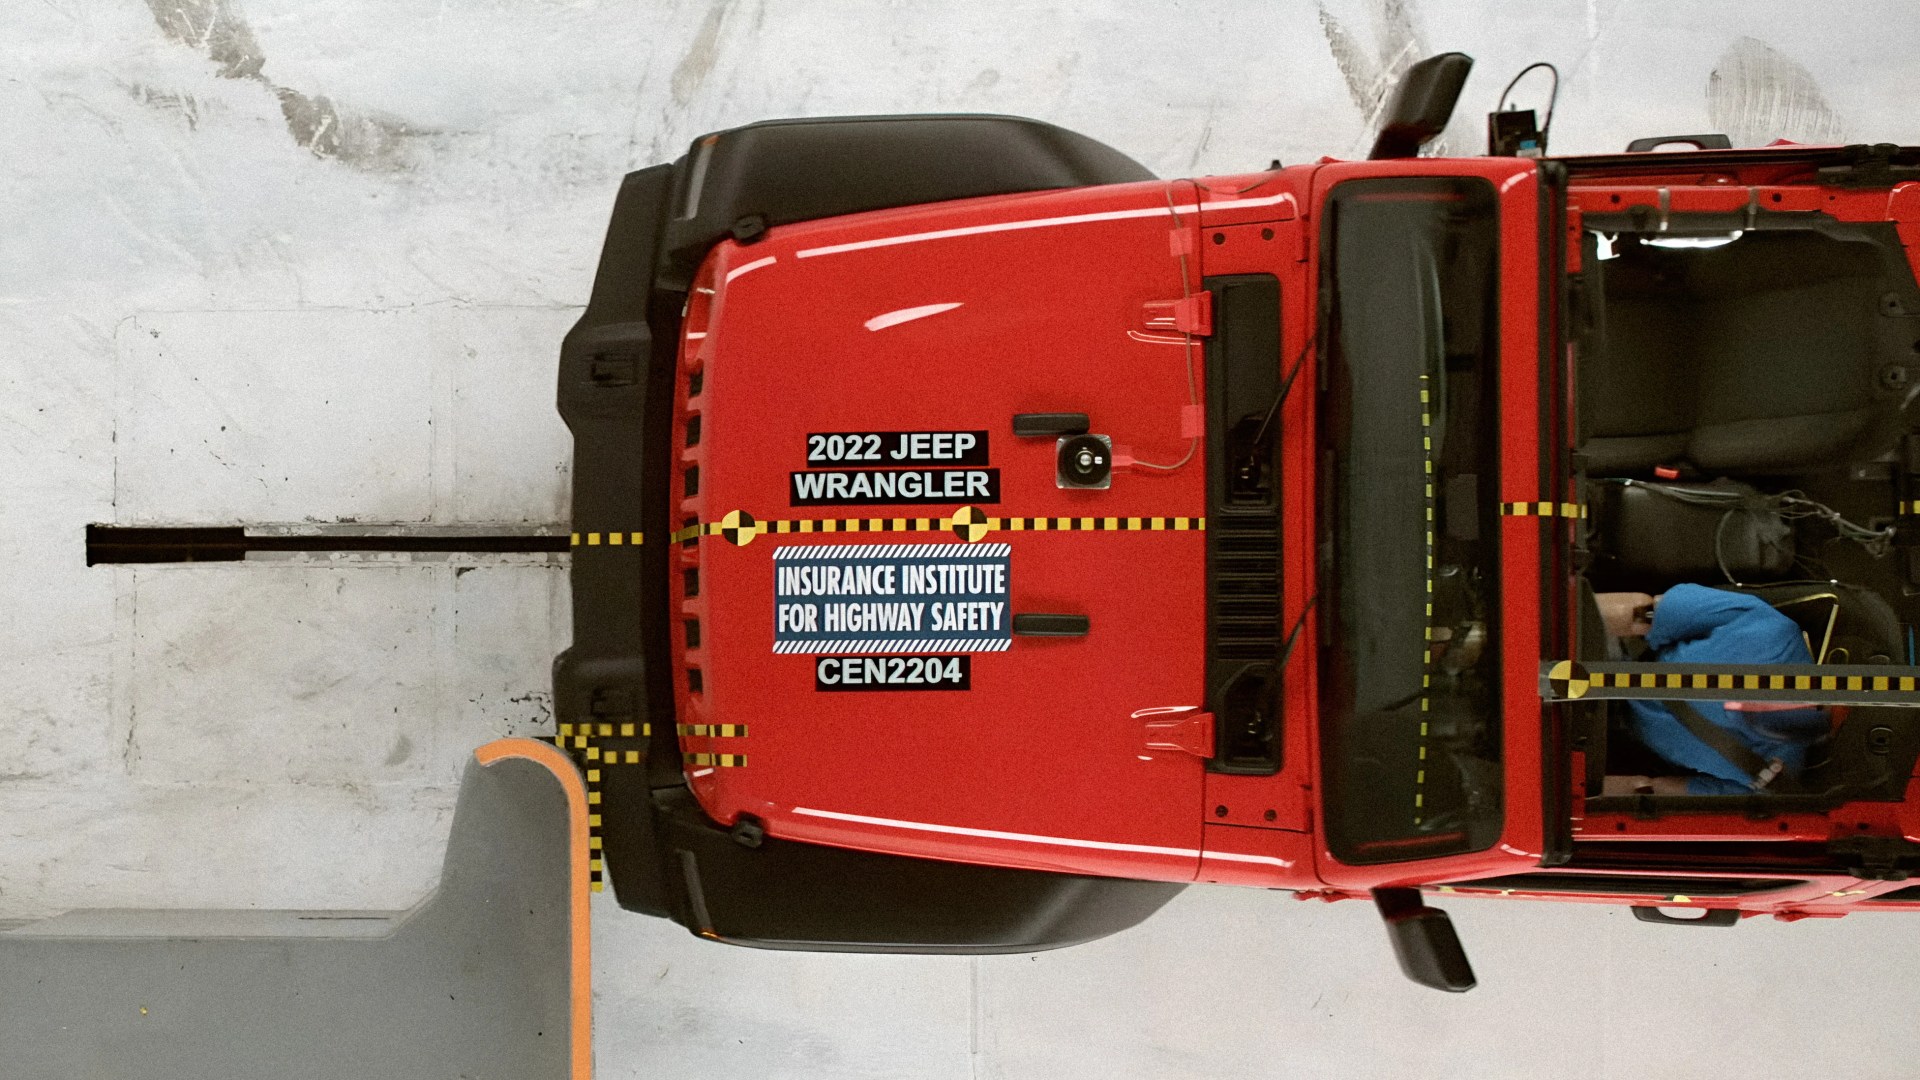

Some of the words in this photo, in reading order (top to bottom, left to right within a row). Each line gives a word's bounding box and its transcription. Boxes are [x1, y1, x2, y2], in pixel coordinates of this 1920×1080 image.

[807, 434, 882, 461] 2022
[890, 433, 976, 460] JEEP
[794, 471, 991, 499] WRANGLER
[778, 565, 896, 596] INSURANCE
[902, 564, 1006, 595] INSTITUTE
[778, 603, 818, 633] FOR
[824, 602, 925, 632] HIGHWAY
[931, 601, 1005, 631] SAFETY
[817, 657, 963, 685] CEN2204
